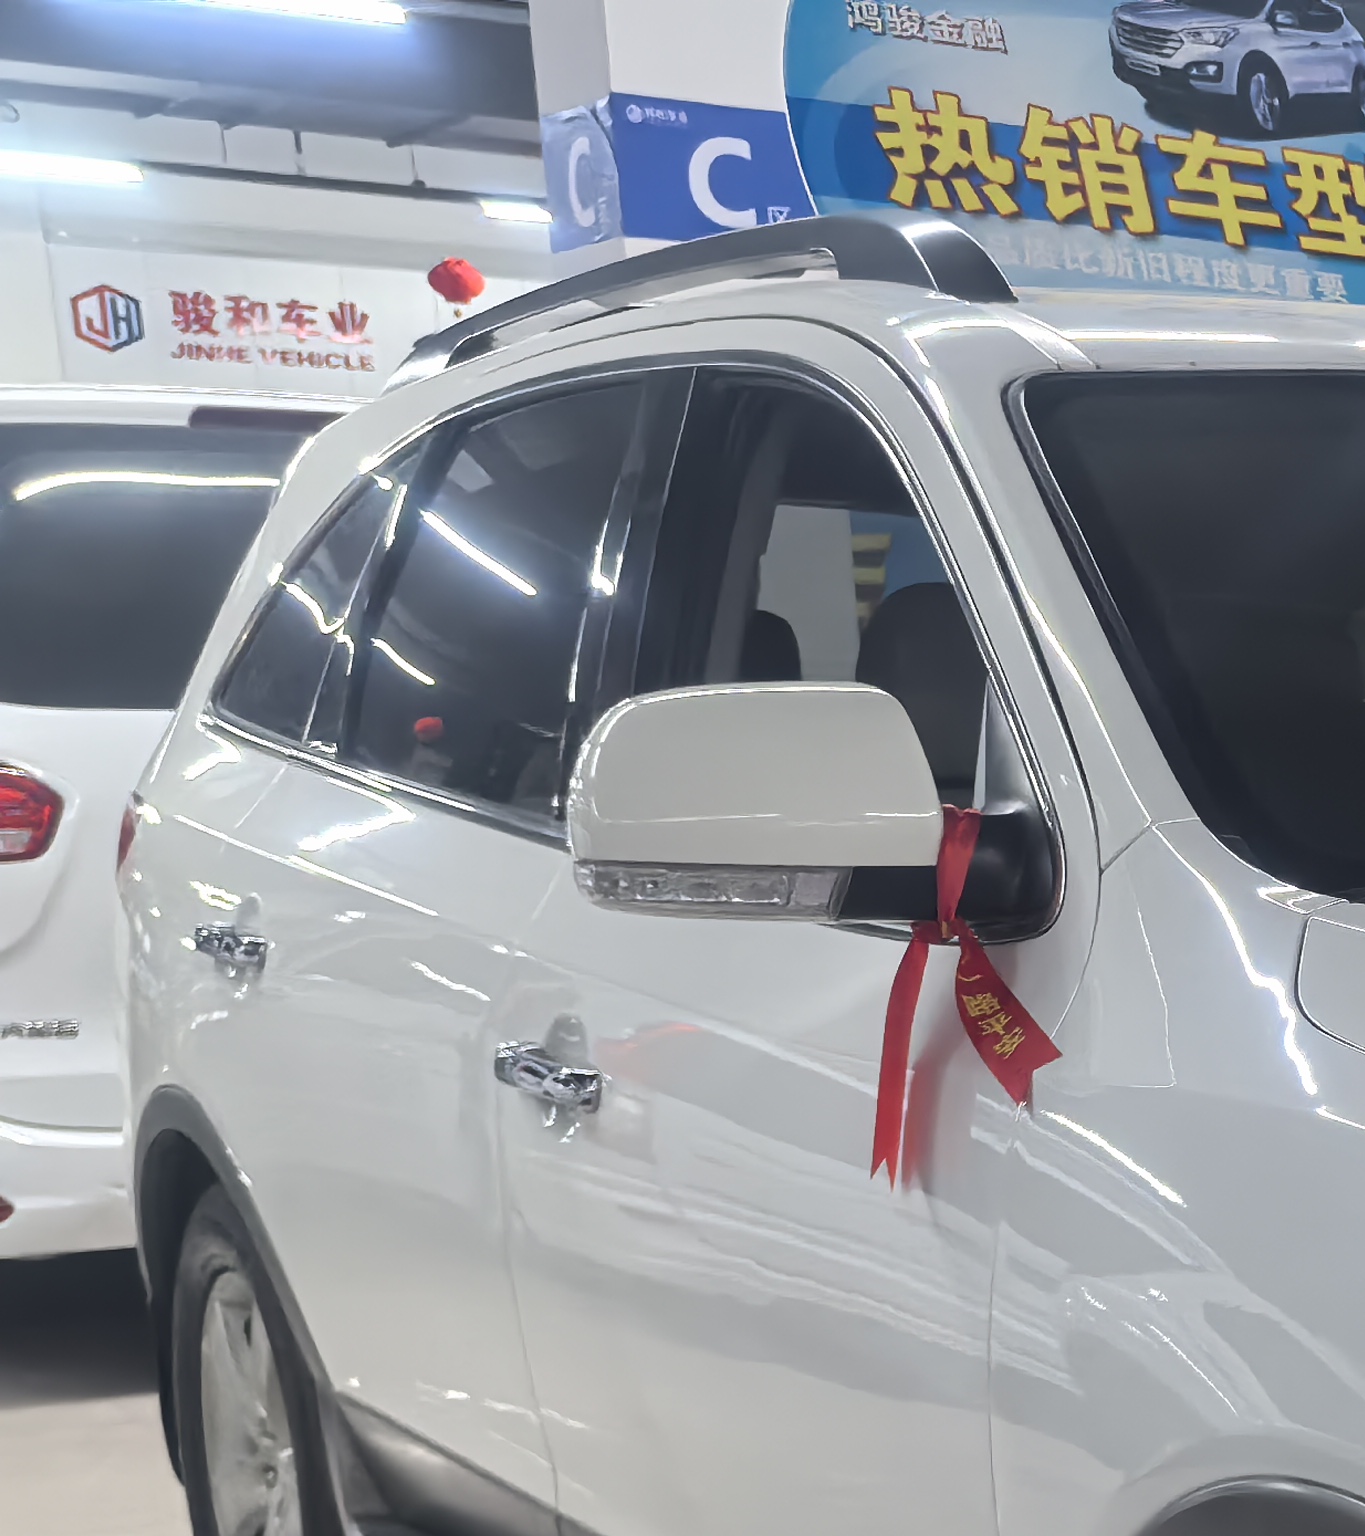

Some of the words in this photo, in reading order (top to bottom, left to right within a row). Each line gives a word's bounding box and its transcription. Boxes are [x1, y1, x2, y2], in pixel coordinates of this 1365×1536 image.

[688, 136, 757, 229] C
[168, 289, 375, 345] 骏和车业
[257, 347, 376, 372] VEHICLE
